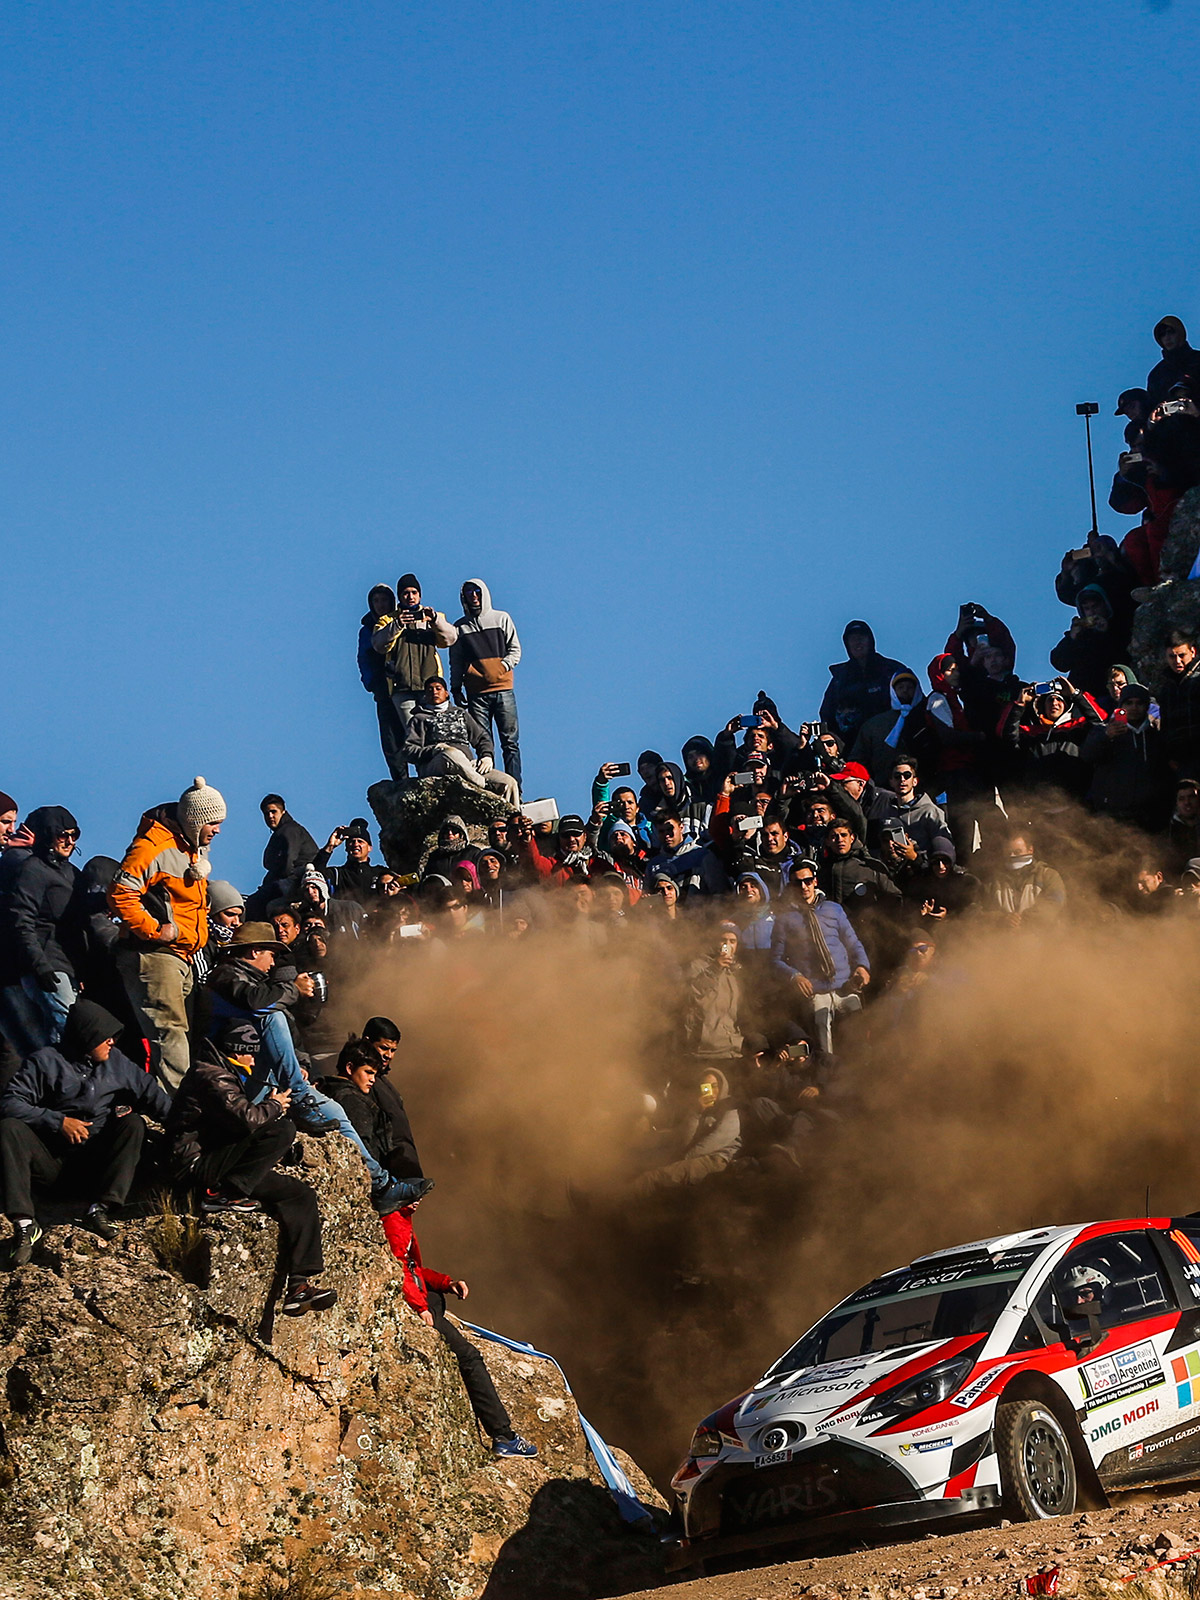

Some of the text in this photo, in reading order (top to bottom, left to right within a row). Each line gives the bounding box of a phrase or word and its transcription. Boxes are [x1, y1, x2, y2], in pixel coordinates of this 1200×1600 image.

[226, 1042, 260, 1053] IPCU
[1117, 1347, 1153, 1365] YPF Rally
[1119, 1357, 1159, 1380] Argentina
[774, 1379, 864, 1402] Microsoft
[814, 1410, 861, 1433] DMG MORI
[862, 1411, 884, 1423] PIAA
[1090, 1398, 1160, 1443] DMG MORI
[911, 1419, 960, 1438] KONECRANES
[918, 1438, 953, 1450] MICHELIN
[1144, 1437, 1175, 1453] TOYOTA
[1175, 1425, 1200, 1441] GAZOO
[760, 1453, 786, 1467] A-5852
